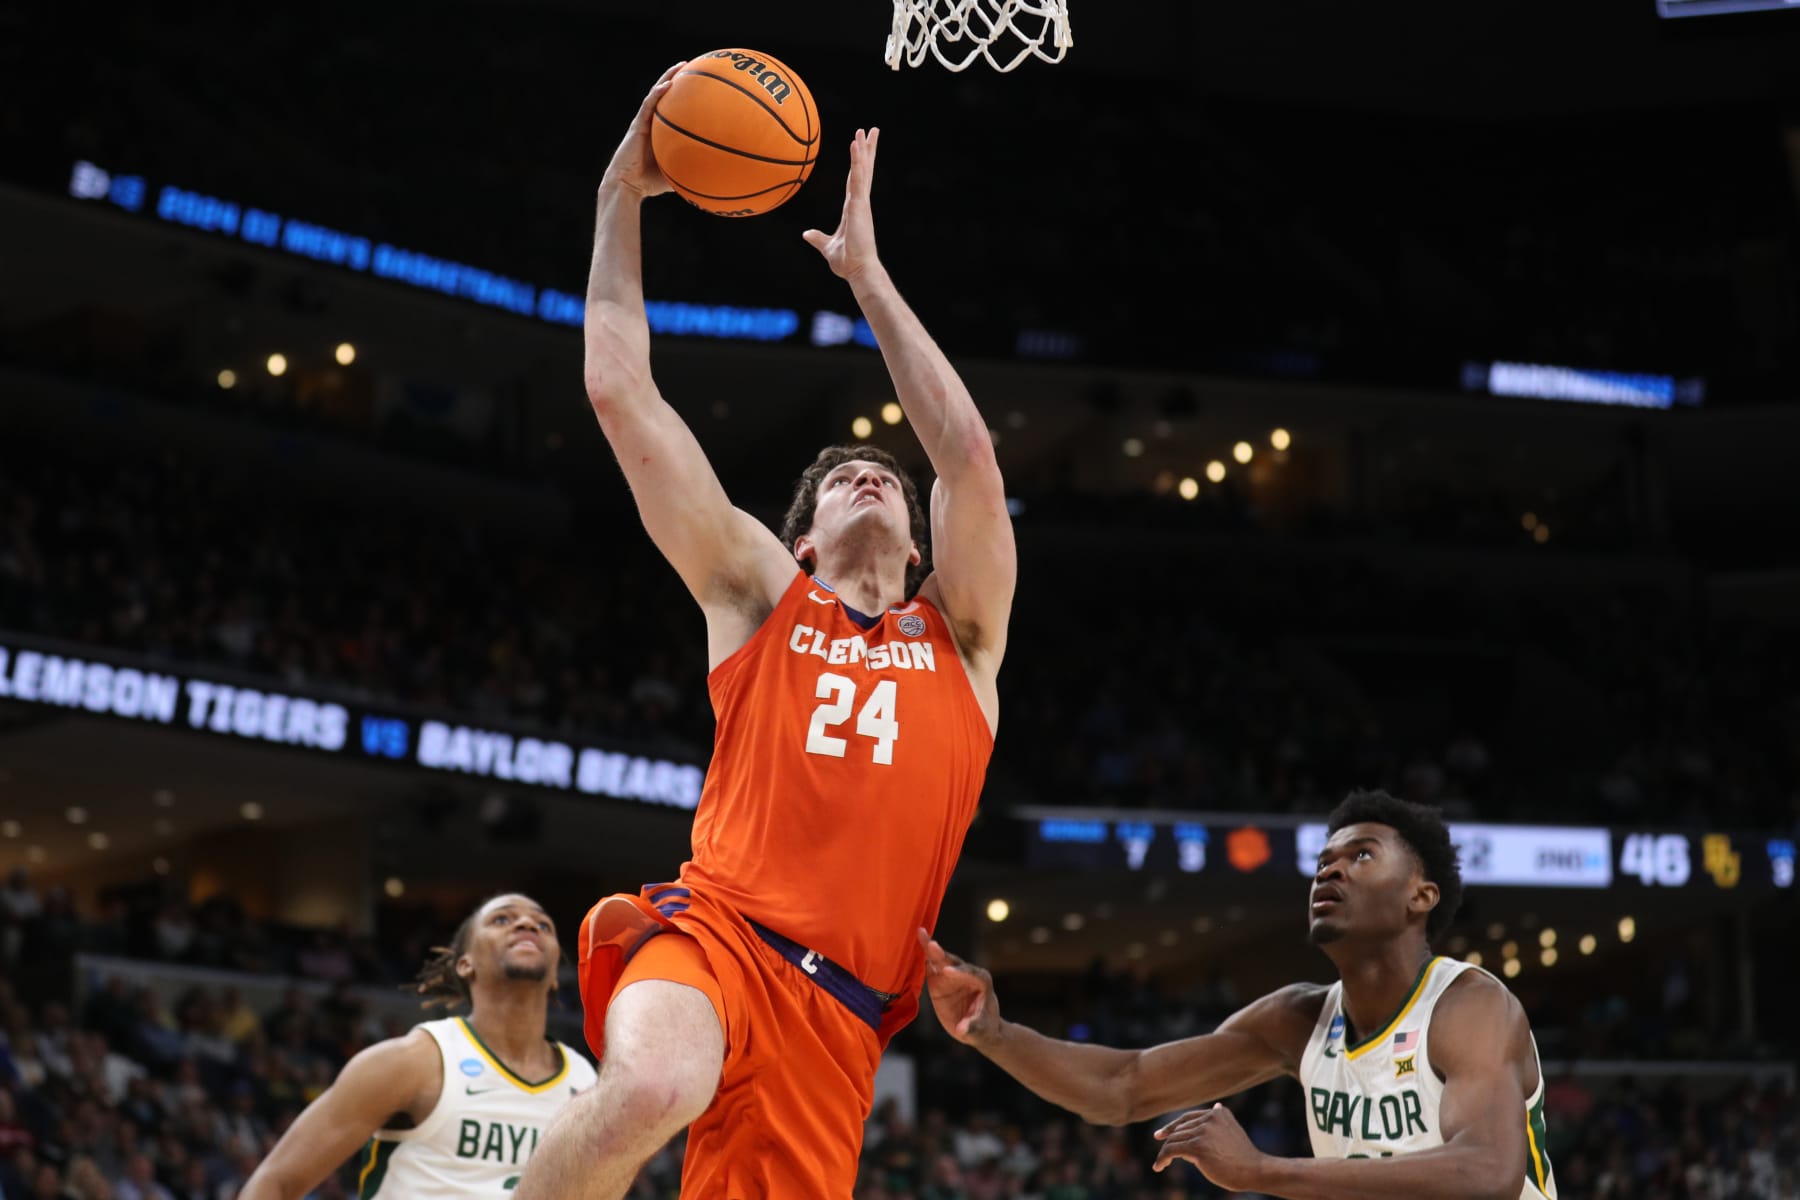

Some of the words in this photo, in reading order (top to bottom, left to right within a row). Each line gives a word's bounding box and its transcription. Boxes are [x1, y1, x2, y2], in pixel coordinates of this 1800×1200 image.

[704, 51, 791, 105] Wilso
[373, 243, 536, 316] BASKETBALL
[789, 623, 936, 672] CLEMSON
[186, 679, 349, 751] TIGERS
[361, 715, 410, 759] VS
[417, 719, 574, 789] BAYLOR
[576, 748, 704, 810] BEARS
[805, 671, 899, 766] 24
[1310, 1086, 1428, 1140] BAYLOR
